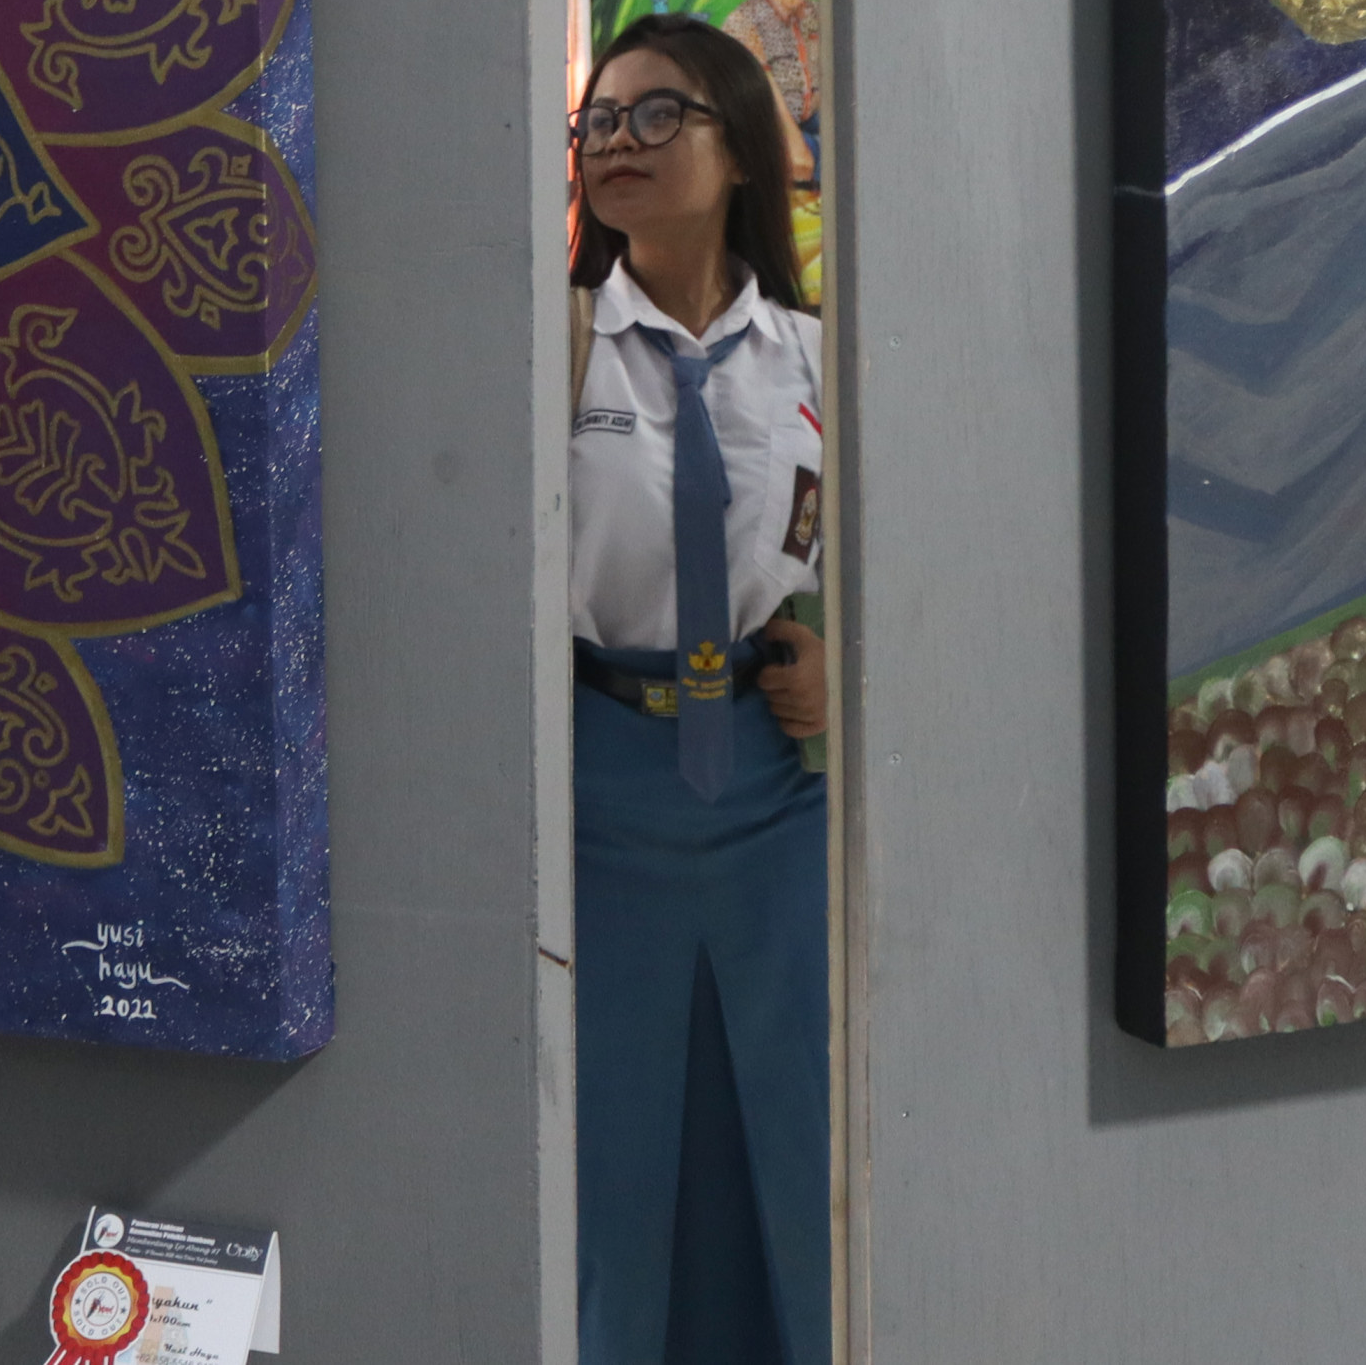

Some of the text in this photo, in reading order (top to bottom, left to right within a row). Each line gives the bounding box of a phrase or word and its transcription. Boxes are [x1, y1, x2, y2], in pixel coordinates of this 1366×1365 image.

[98, 952, 190, 990] hayu
[80, 1275, 128, 1301] SOLD OUT
[73, 1310, 96, 1336] SOLD
[100, 1317, 123, 1336] OUT
